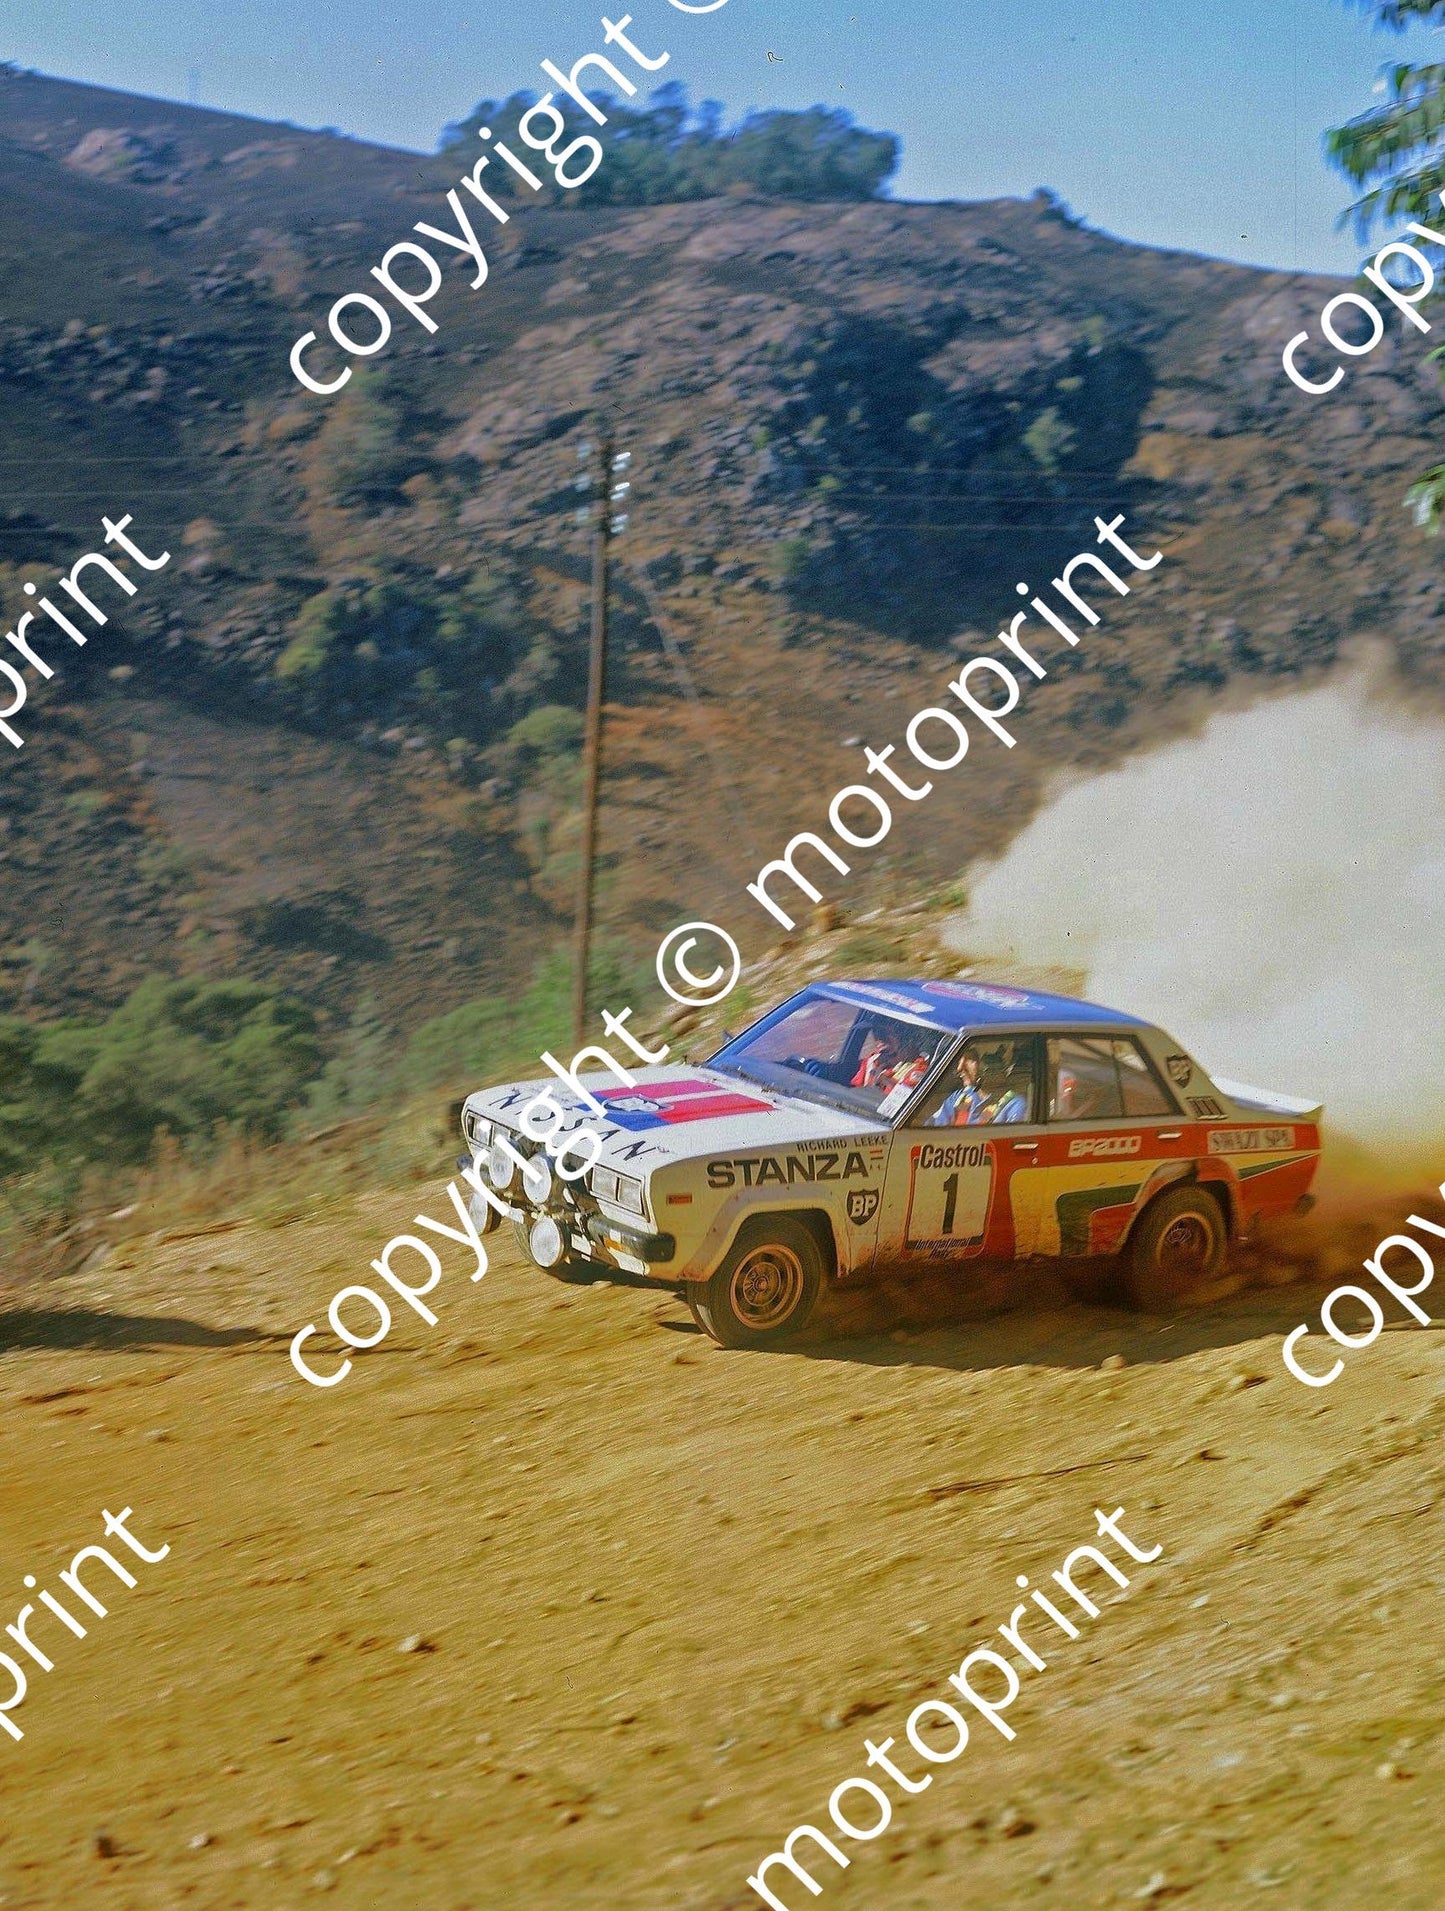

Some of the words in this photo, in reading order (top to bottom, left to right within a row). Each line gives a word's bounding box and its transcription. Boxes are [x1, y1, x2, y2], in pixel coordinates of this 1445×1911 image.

[796, 1137, 847, 1153] RICHARD
[920, 1143, 985, 1169] Castrol
[706, 1151, 869, 1188] STANZA
[850, 1194, 877, 1217] BP
[942, 1173, 960, 1234] 1
